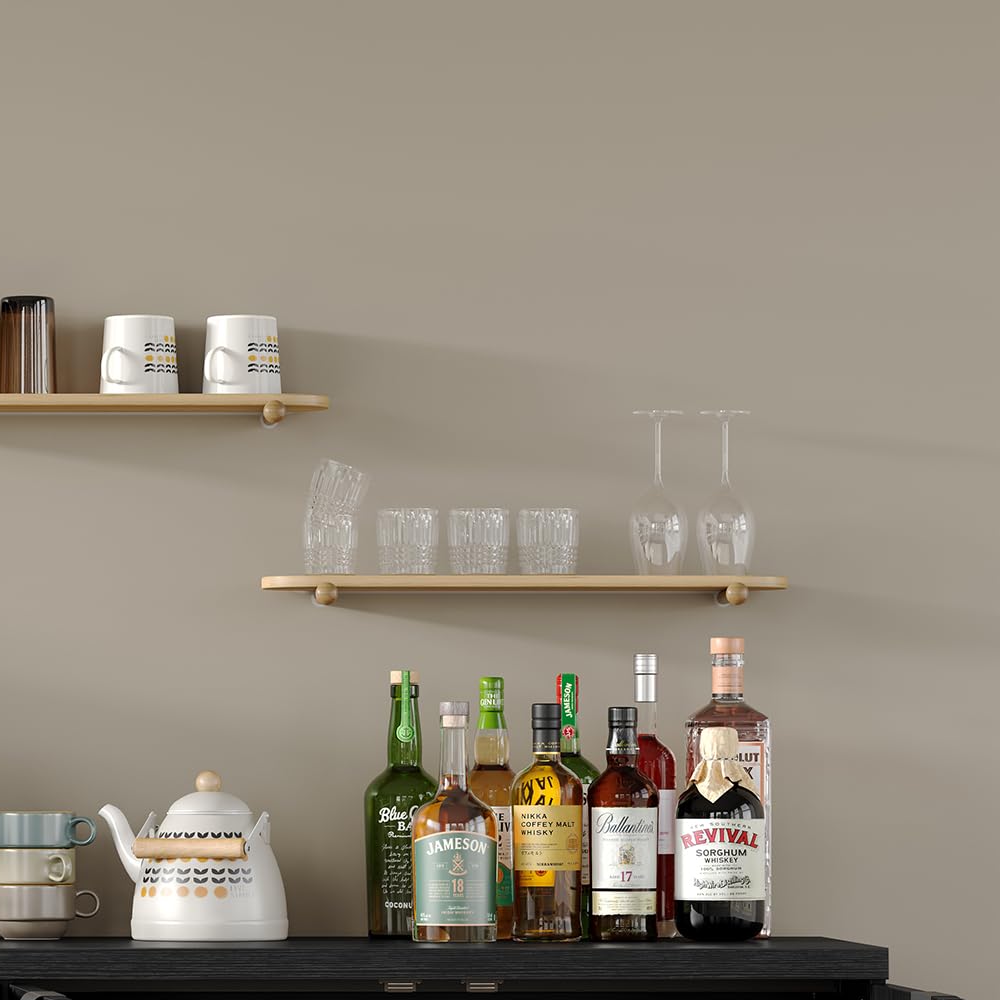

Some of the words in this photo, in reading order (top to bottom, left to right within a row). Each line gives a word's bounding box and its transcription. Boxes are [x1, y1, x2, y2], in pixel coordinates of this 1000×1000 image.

[564, 682, 573, 718] JAMESON
[378, 805, 408, 823] Blue
[427, 838, 487, 855] JAMESON
[681, 828, 758, 849] REVIVAL
[696, 849, 747, 857] SORGHUM
[620, 870, 633, 882] 17
[451, 878, 465, 893] 18
[384, 901, 412, 909] COCONU
